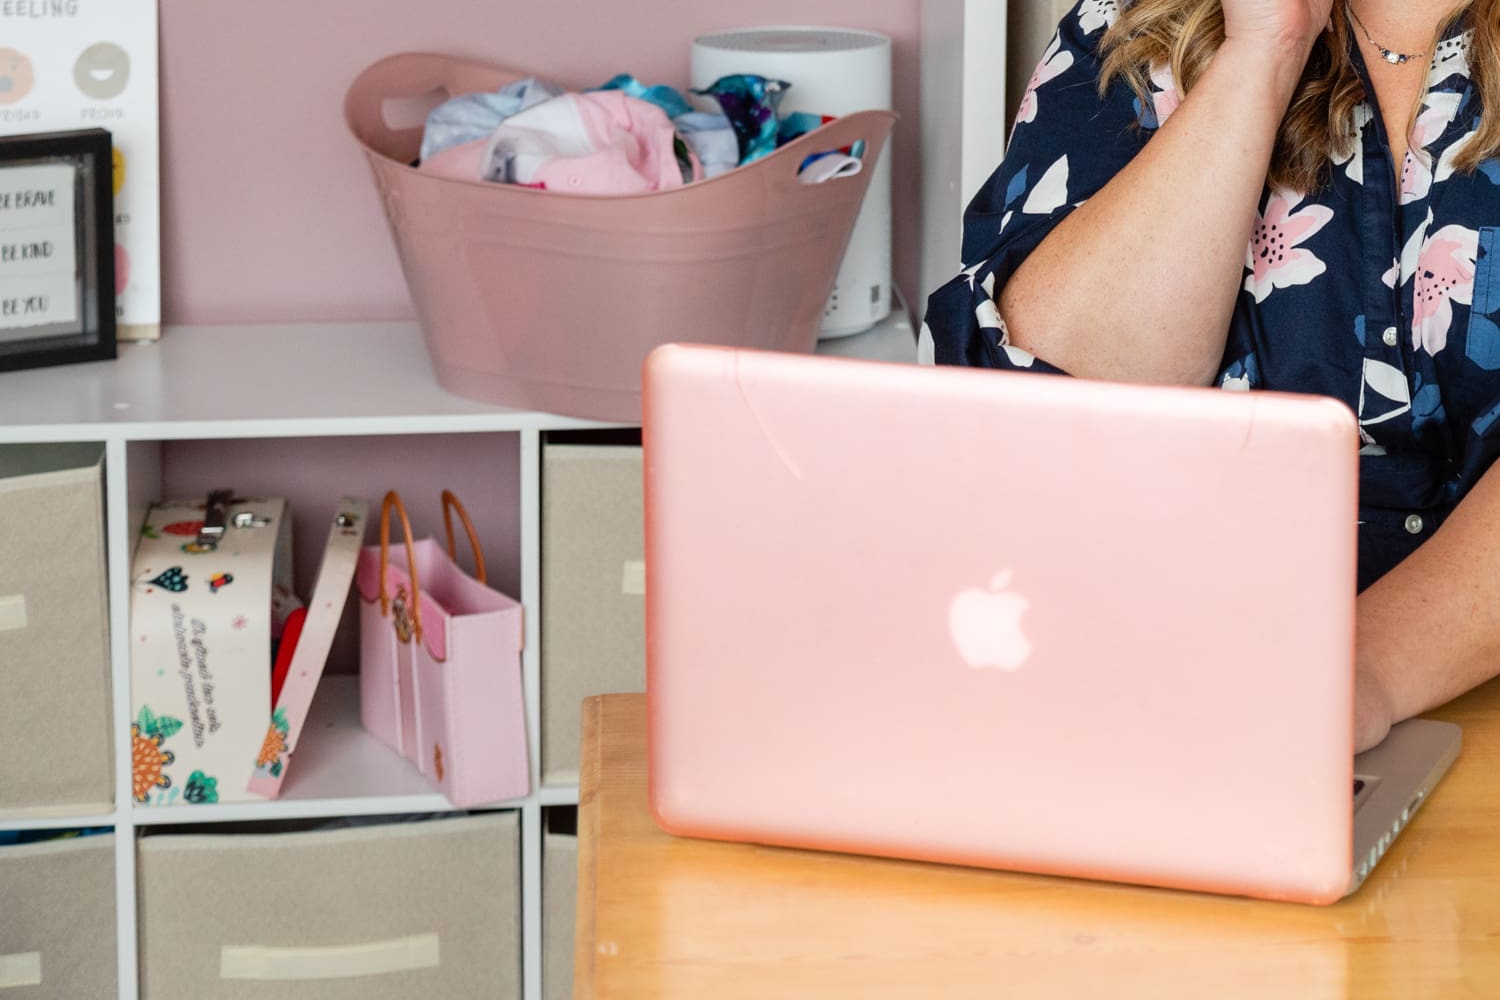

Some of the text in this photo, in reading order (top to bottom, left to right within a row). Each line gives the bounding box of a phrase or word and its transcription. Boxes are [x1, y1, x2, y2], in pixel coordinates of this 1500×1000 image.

[15, 188, 55, 209] BRAVE
[1, 240, 54, 261] BE KIND
[2, 296, 49, 316] BE YOU
